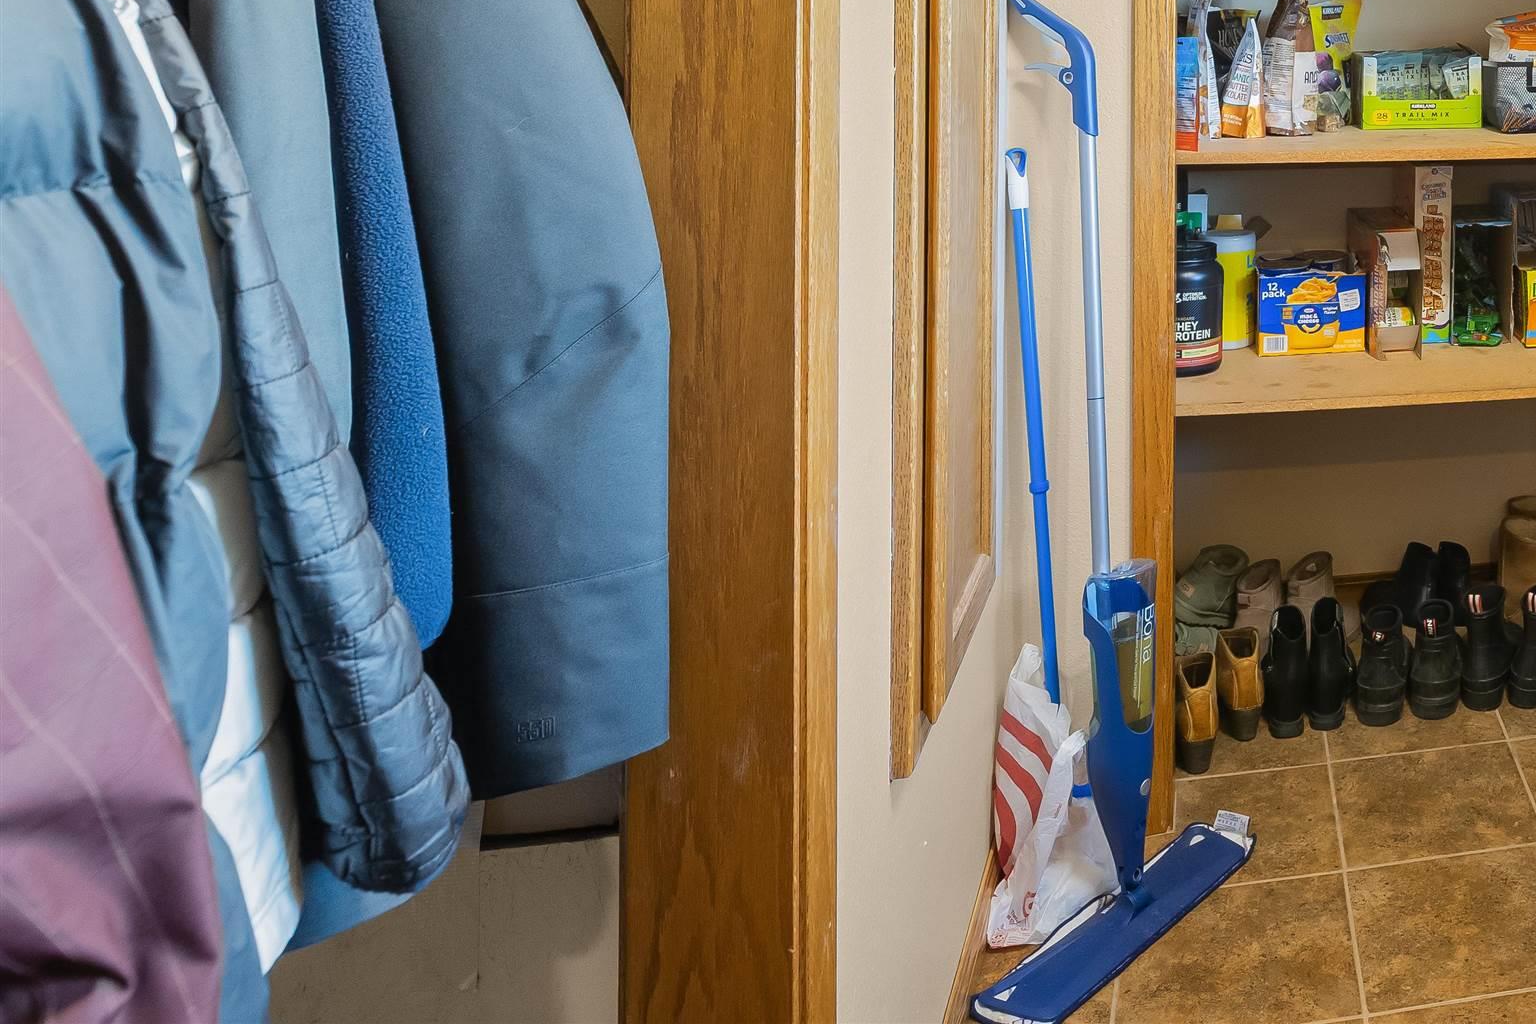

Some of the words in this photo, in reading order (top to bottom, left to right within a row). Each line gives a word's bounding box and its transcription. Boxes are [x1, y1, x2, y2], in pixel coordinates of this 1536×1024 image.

[1376, 112, 1388, 120] 28
[1267, 282, 1278, 291] 12
[1262, 288, 1286, 300] pack
[1175, 328, 1211, 342] ROTEIN
[1143, 603, 1155, 664] Bona
